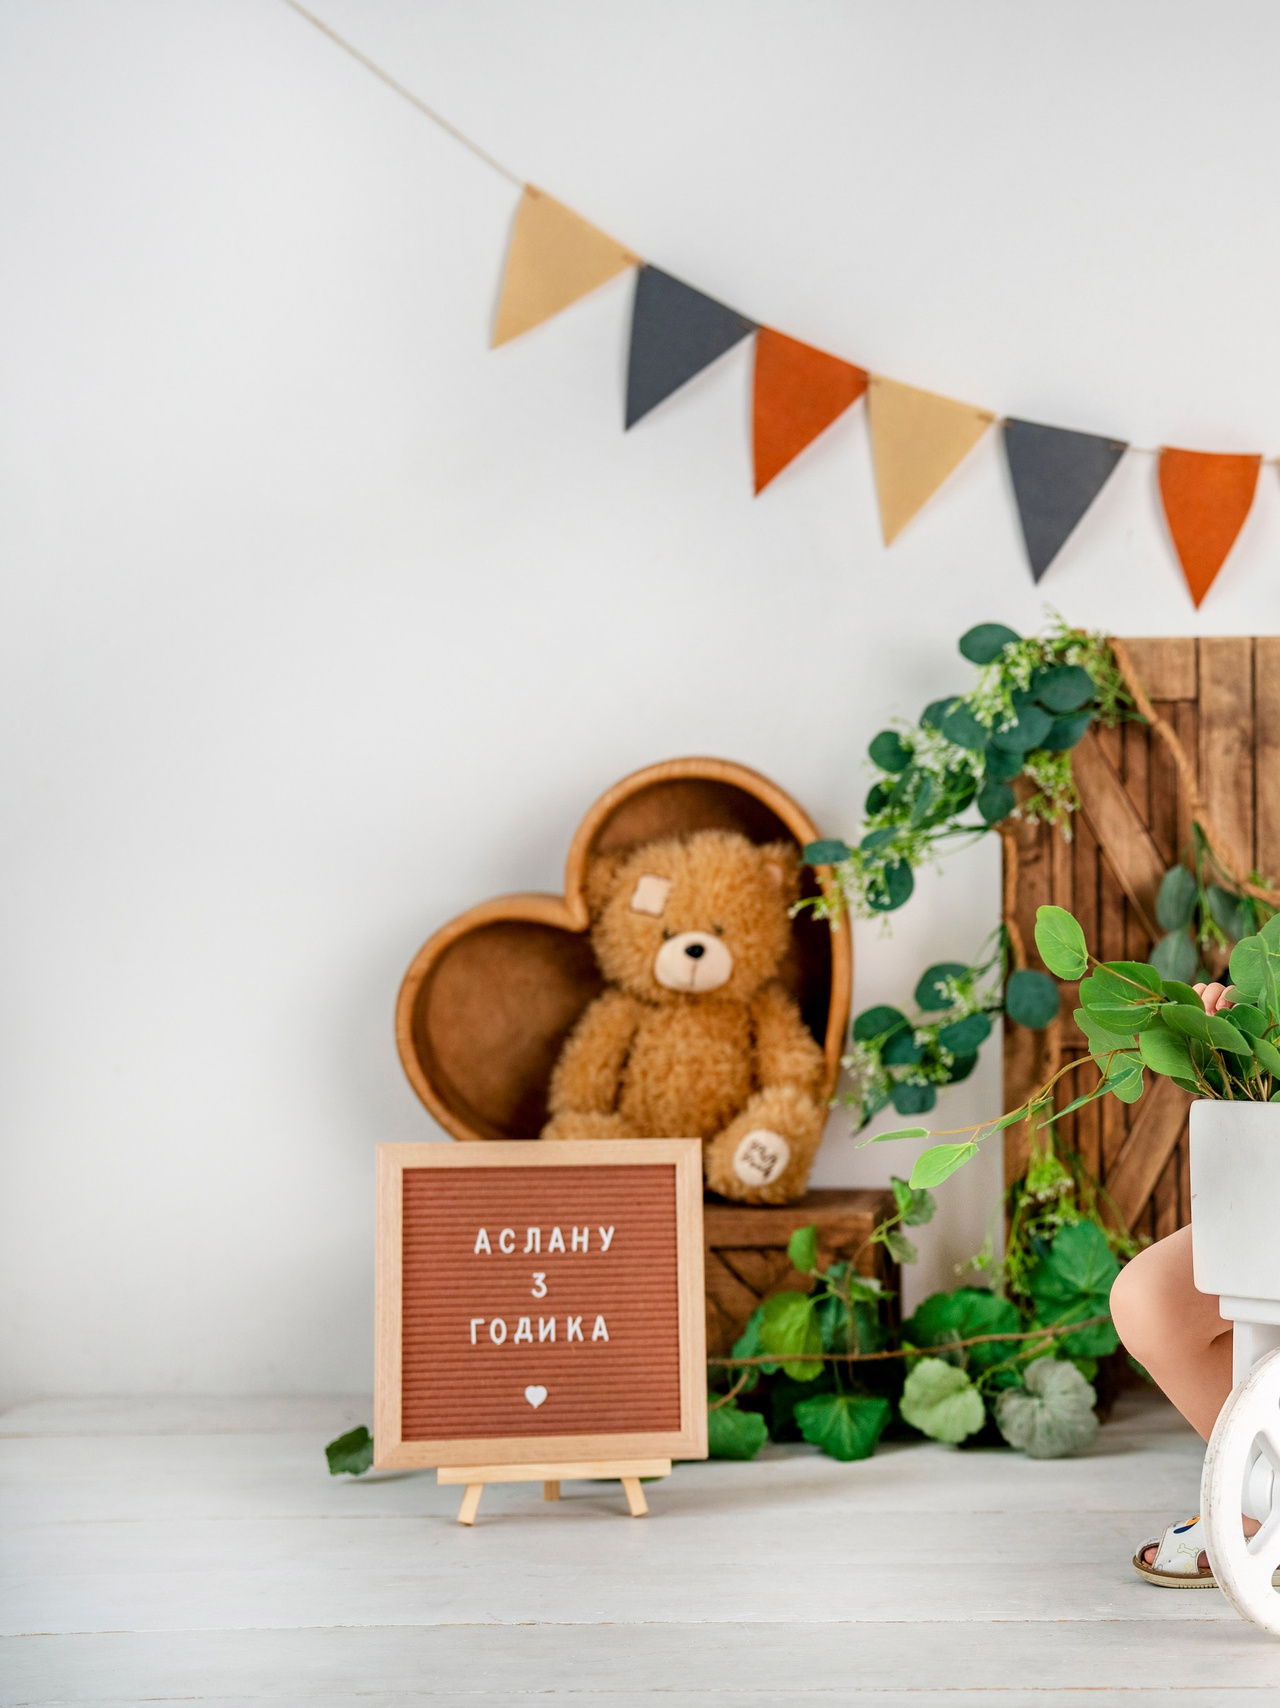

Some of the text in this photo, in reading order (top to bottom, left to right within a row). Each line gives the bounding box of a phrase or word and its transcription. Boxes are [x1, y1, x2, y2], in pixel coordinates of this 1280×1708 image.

[474, 1225, 615, 1255] АСЛАНУ
[531, 1272, 548, 1299] 3
[470, 1314, 609, 1346] ГОДИКА
